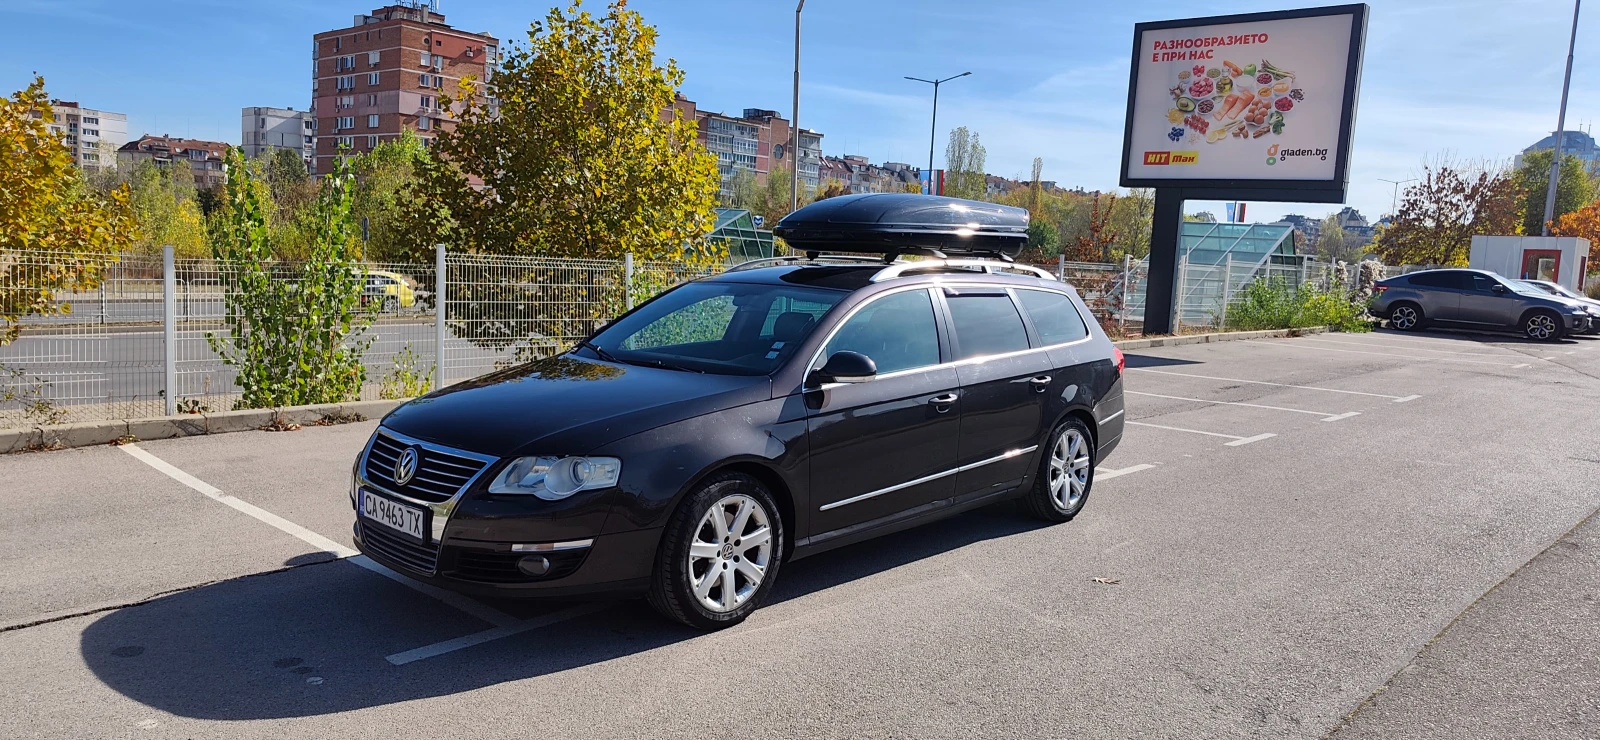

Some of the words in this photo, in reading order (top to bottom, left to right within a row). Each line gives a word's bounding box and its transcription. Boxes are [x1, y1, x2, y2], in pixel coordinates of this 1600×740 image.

[1154, 33, 1268, 50] РАЗНООБРАЗИЕТО
[1152, 53, 1159, 62] Е
[1162, 51, 1186, 61] ПРИ
[1189, 49, 1213, 60] НАС
[1147, 154, 1168, 163] HIT
[1280, 148, 1328, 161] gladen.bg
[365, 494, 378, 518] CA
[379, 500, 404, 528] 9463
[406, 510, 421, 535] TX
